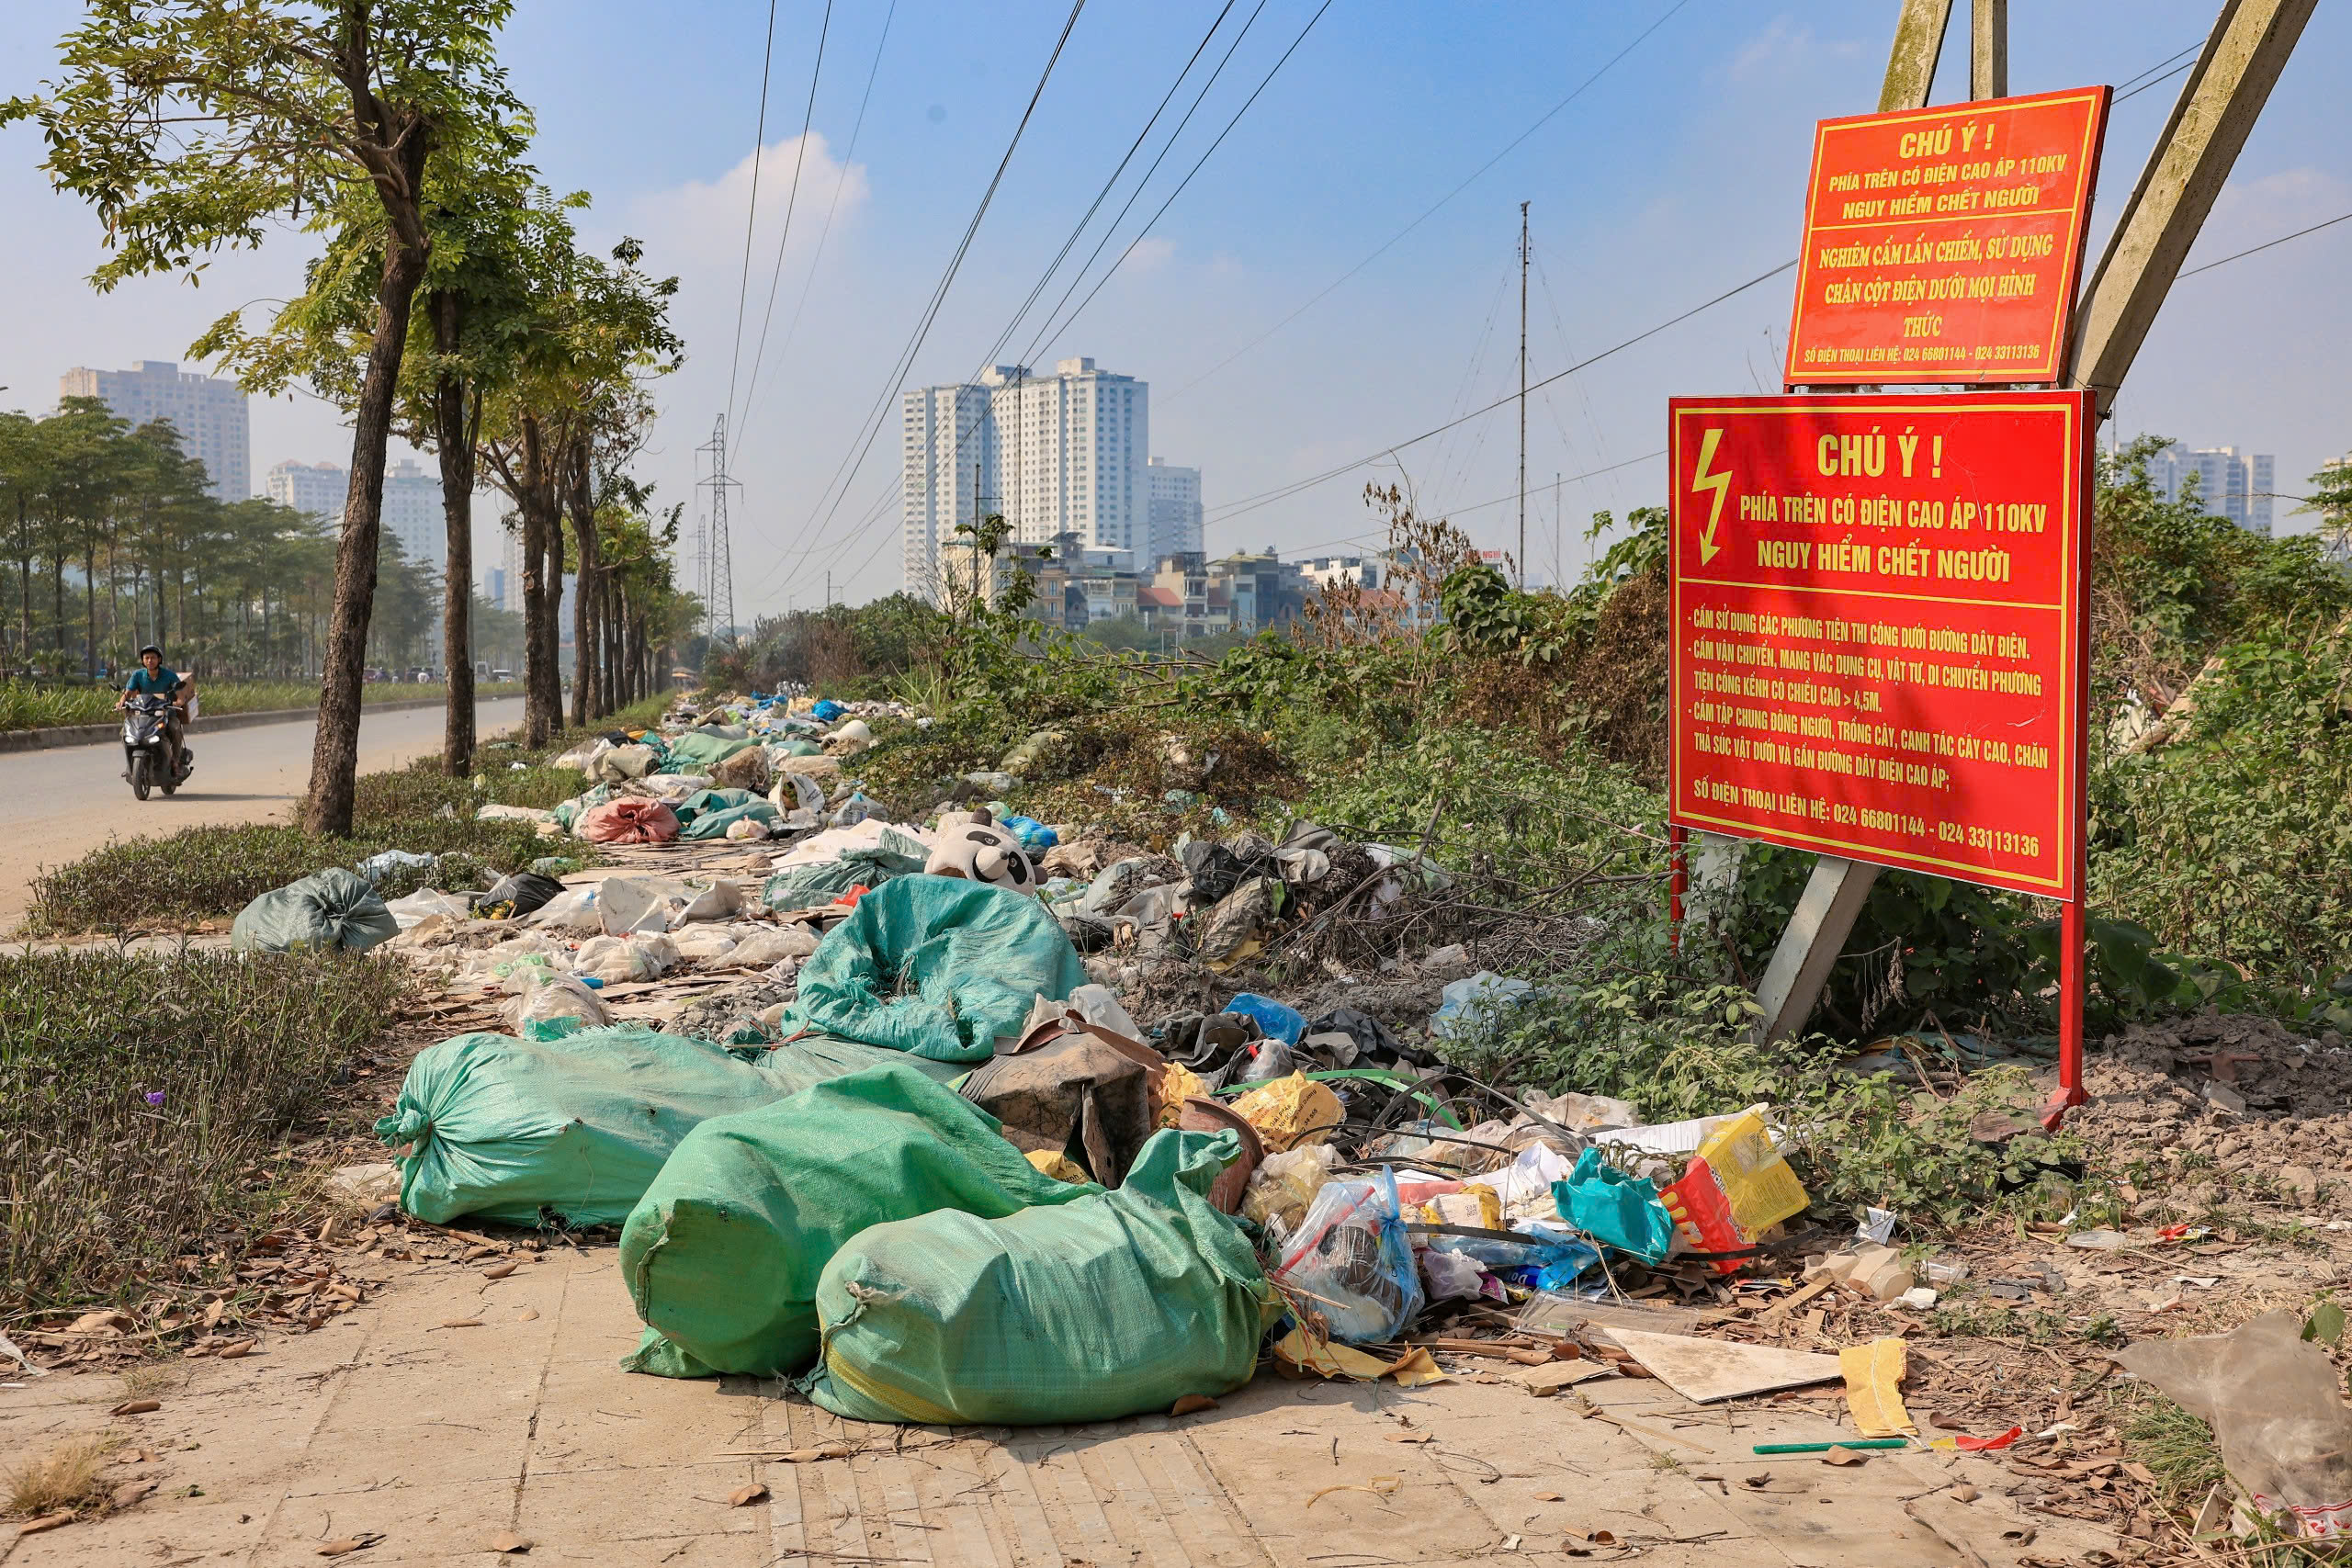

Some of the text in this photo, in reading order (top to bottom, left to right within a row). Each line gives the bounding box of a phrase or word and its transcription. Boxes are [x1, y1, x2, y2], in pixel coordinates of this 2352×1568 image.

[1899, 120, 1996, 159] CHÚ Ý !
[1828, 153, 2067, 192] PHÍA TRÊN CÓ ĐIỆN CAO ÁP 110KV
[1842, 183, 2040, 220] NGUY HIỂM CHẾT NGƯỜI
[1819, 228, 2054, 269] NGHIÊM CẤM LẤN CHIẾM, SỬ DỤNG
[1825, 268, 2037, 307] CHÂN CỘT ĐIỆN DƯỚI MỌI HÌNH
[1904, 310, 1943, 338] THỨC
[1817, 426, 1942, 478] CHÚ Ý !
[1740, 491, 2047, 533] PHÍA TRÊN CÓ ĐIỆN CAO ÁP 110KV
[1758, 533, 2010, 582] NGUY HIỂM CHẾT NGƯỜI
[1693, 603, 1714, 628] CẤM
[1715, 603, 1729, 630] SỬ
[1730, 612, 1757, 636] DỤNG
[1758, 611, 1779, 636] CÁC
[1781, 616, 1823, 639] PHƯƠNG
[1825, 617, 1849, 646] TIỆN
[1850, 622, 1868, 644] THI
[1870, 620, 1899, 647] CÔNG
[1901, 622, 1927, 649] DƯỚI
[1928, 625, 1968, 654] ĐƯỜNG
[1971, 629, 1995, 656] DÂY
[1997, 632, 2030, 663] ĐIỆN.
[1693, 634, 1714, 660] CẤM
[1715, 639, 1735, 666] VẬN
[1736, 639, 1778, 670] CHUYỂN,
[1780, 649, 1811, 671] MANG
[1812, 649, 1834, 673] VÁC
[1836, 654, 1865, 680] DỤNG
[1867, 658, 1884, 683] CỤ,
[1886, 656, 1906, 685] VẬT
[1908, 661, 1926, 687] TƯ,
[1928, 664, 1939, 686] DI
[1942, 660, 1988, 691] CHUYỂN
[1991, 671, 2041, 696] PHƯƠNG
[1694, 668, 1714, 694] TIỆN
[1715, 668, 1741, 695] CỒNG
[1743, 671, 1770, 698] KỀNH
[1771, 677, 1785, 701] CÓ
[1787, 677, 1818, 705] CHIỀU
[1819, 685, 1841, 707] CAO
[1853, 690, 1882, 713] 4,5M.
[1693, 696, 1714, 722] CẤM
[1716, 702, 1734, 728] TẬP
[1736, 707, 1769, 730] CHUNG
[1770, 709, 1798, 735] ĐÔNG
[1800, 713, 1836, 742] NGƯỜI,
[1838, 716, 1872, 744] TRỒNG
[1874, 722, 1898, 750] CÂY,
[1900, 729, 1930, 753] CANH
[1933, 730, 1955, 757] TÁC
[1957, 733, 1981, 760] CÂY
[1984, 739, 2012, 767] CAO,
[2014, 742, 2049, 769] CHĂN
[1693, 726, 1950, 792] THẢ SÚC VẬT DƯỚI VÀ GẦN ĐƯỜNG DÂY ĐIỆN CAO ÁP;
[1694, 775, 1709, 799] SỐ
[1711, 781, 1739, 807] ĐIỆN
[1741, 787, 1776, 814] THOẠI
[1779, 793, 1807, 817] LIÊN
[1810, 796, 1830, 823] HỆ:
[1833, 803, 1858, 825] 024
[1860, 808, 1926, 837] 66801144
[1939, 820, 1964, 844] 024
[1968, 826, 2040, 858] 33113136
